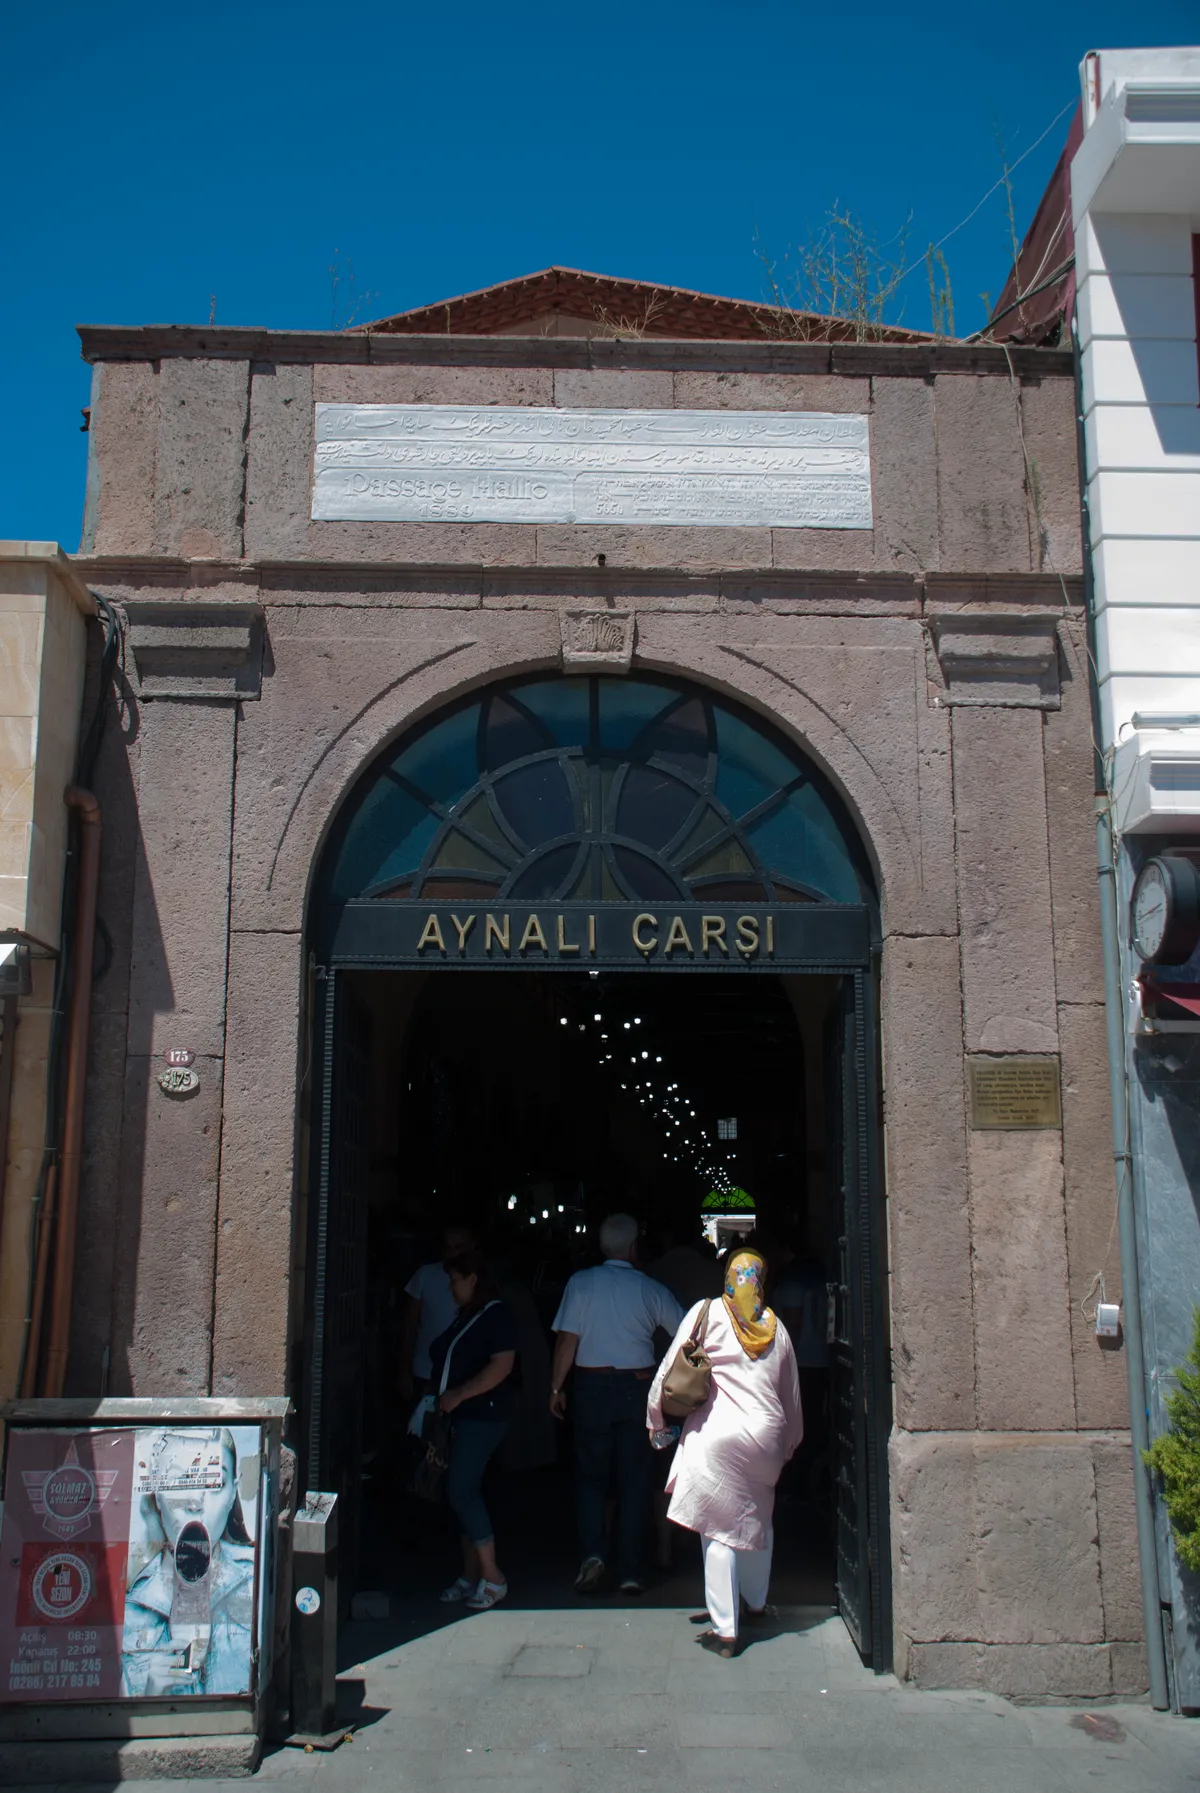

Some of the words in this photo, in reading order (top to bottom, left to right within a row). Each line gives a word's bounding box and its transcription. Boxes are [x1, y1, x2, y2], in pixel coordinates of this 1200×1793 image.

[344, 473, 462, 503] Passage
[472, 476, 548, 500] Hallio
[418, 504, 474, 519] 1889
[596, 502, 624, 516] 5650
[416, 913, 596, 951] AYNALI
[171, 1051, 189, 1062] 175
[172, 1070, 191, 1085] 175
[50, 1482, 87, 1494] SOLMAZ
[50, 1586, 73, 1602] SEZON
[67, 1630, 97, 1641] 08:30
[67, 1645, 96, 1656] 22:00
[43, 1660, 58, 1674] Cd
[60, 1659, 78, 1673] No:
[81, 1658, 102, 1672] 245
[47, 1675, 68, 1688] 217
